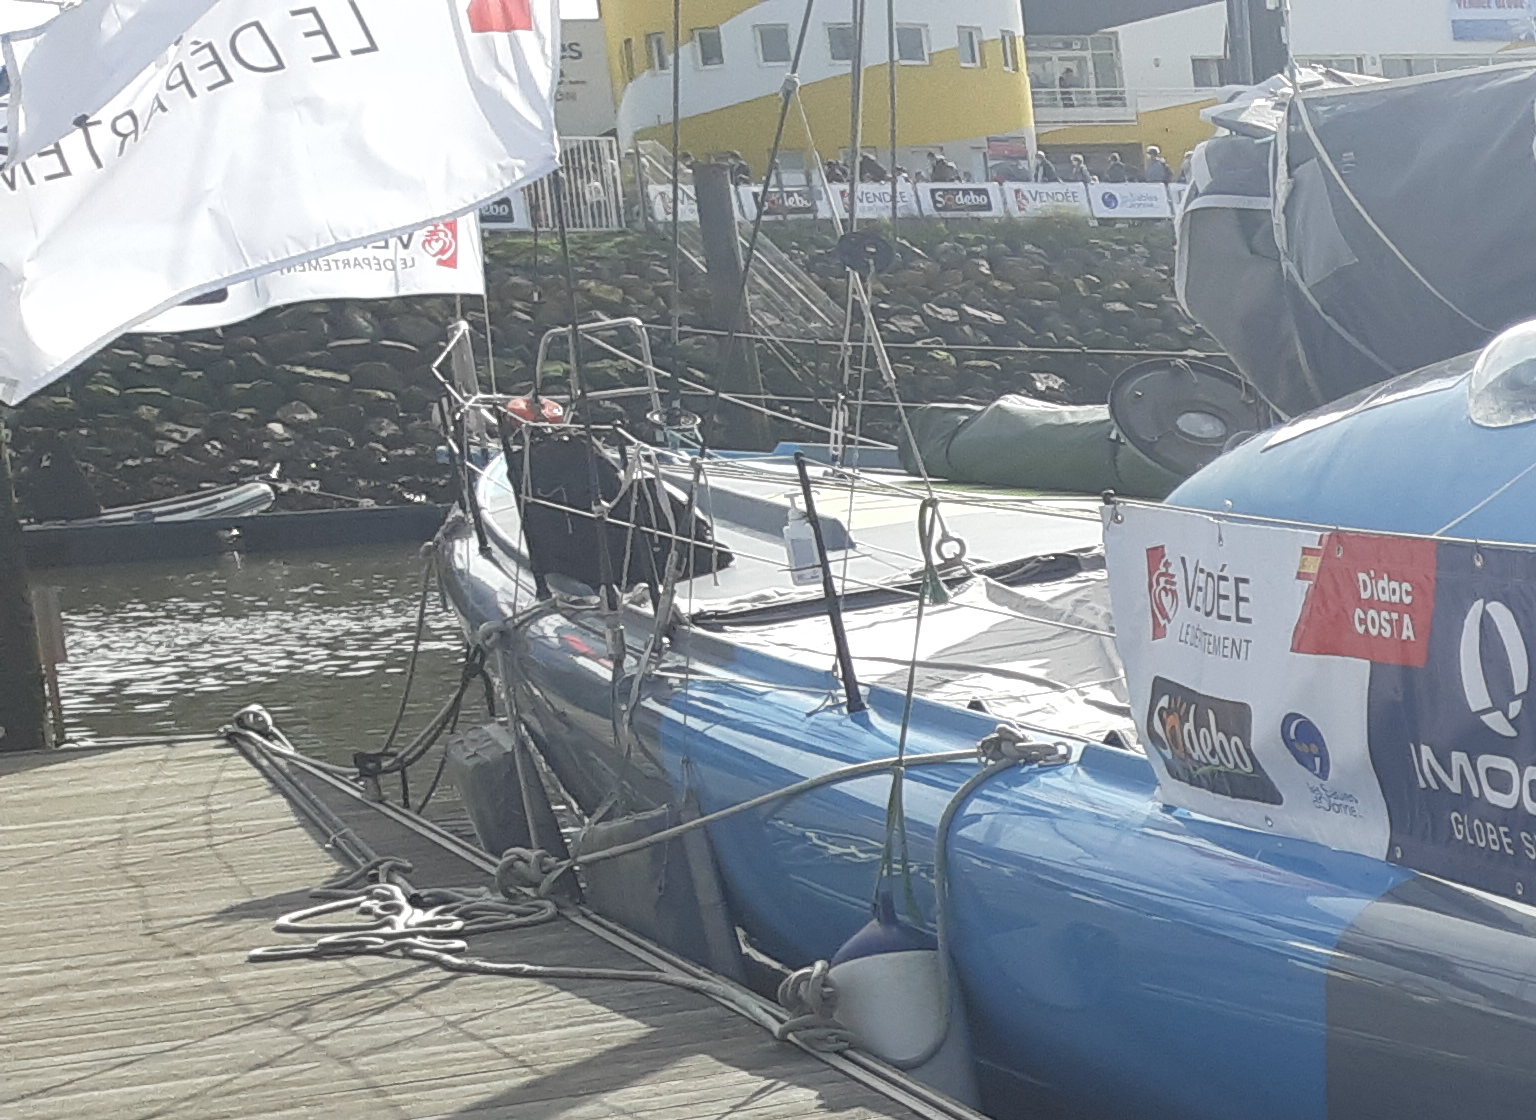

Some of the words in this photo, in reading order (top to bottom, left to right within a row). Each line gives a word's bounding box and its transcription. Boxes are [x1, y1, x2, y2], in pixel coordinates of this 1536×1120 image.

[935, 189, 989, 208] Sodebo
[1028, 188, 1079, 203] VENDÉE
[1357, 569, 1413, 605] Didac
[1354, 608, 1416, 642] COSTA
[1153, 695, 1254, 774] Sodebo
[1451, 812, 1515, 856] GLOBE
